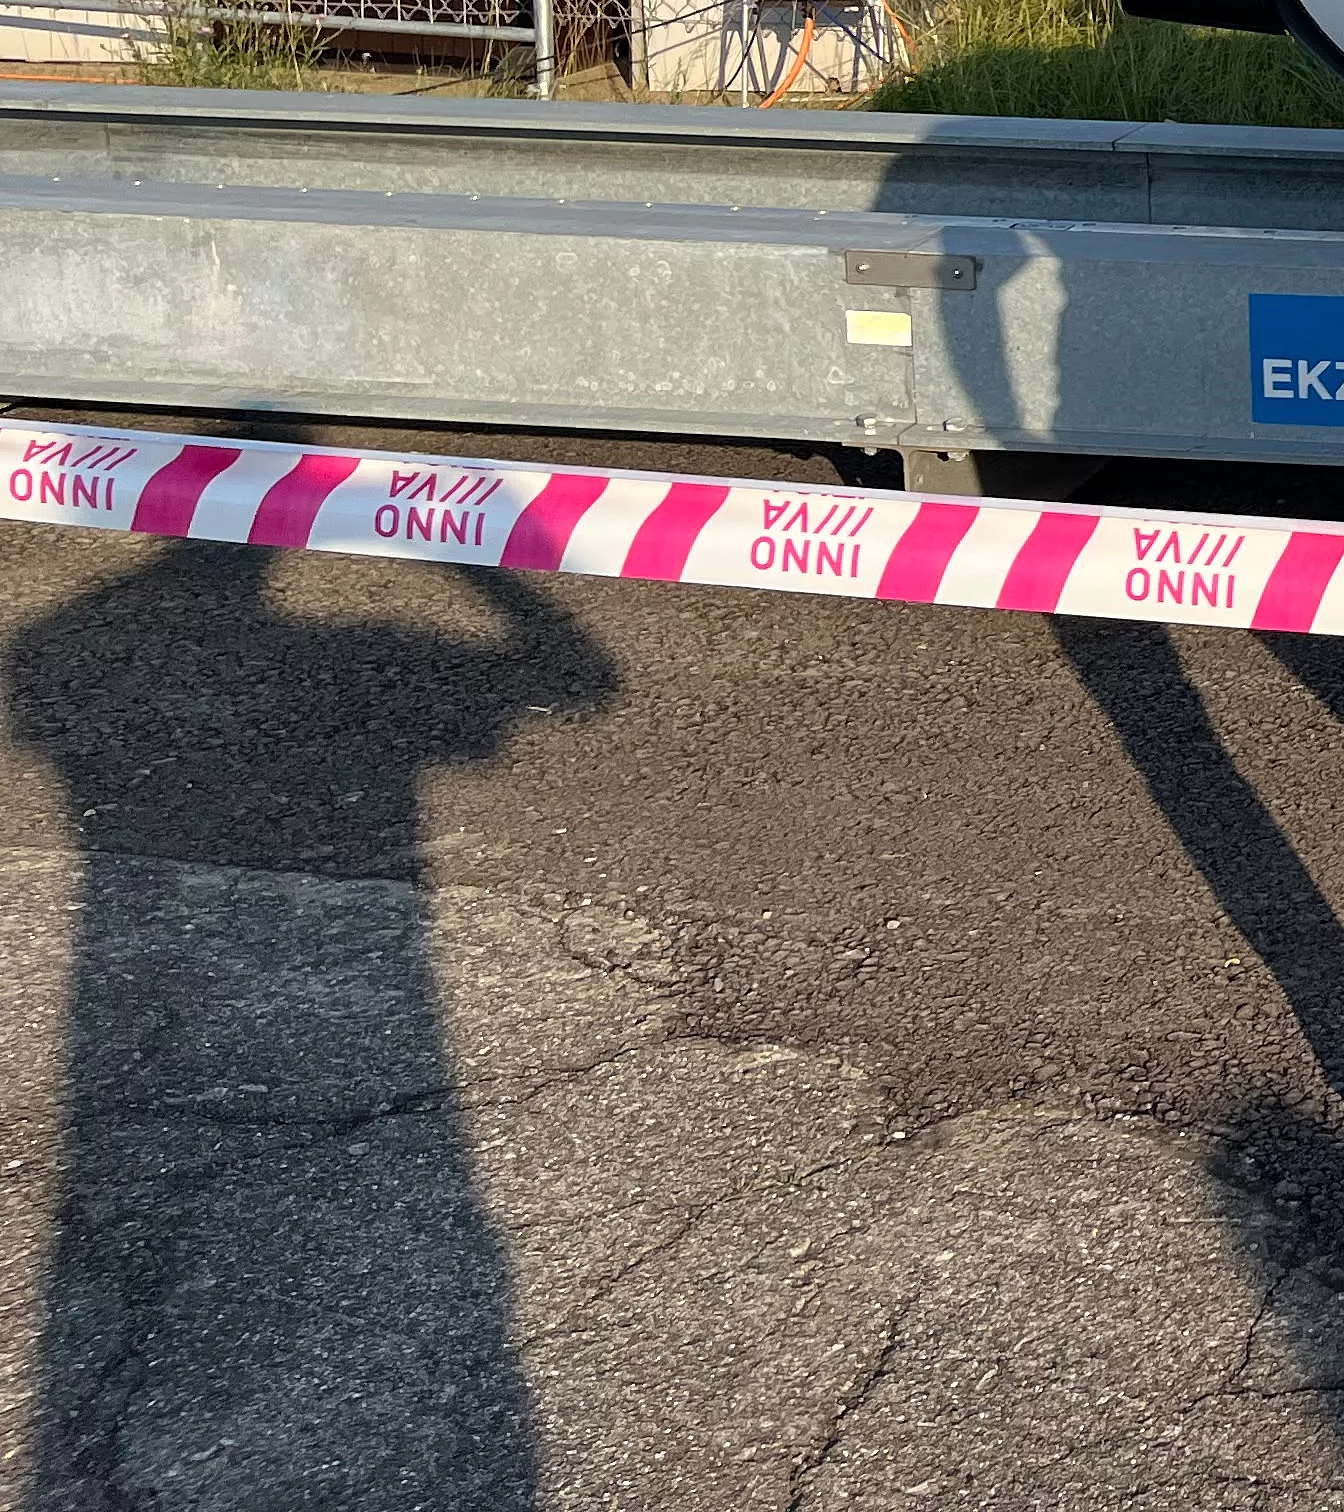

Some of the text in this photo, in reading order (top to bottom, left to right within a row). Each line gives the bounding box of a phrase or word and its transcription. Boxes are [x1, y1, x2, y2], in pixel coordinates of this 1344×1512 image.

[10, 468, 113, 511] INNO
[374, 504, 486, 547] INNO
[750, 536, 861, 578] INNO
[1125, 567, 1236, 609] INNO
